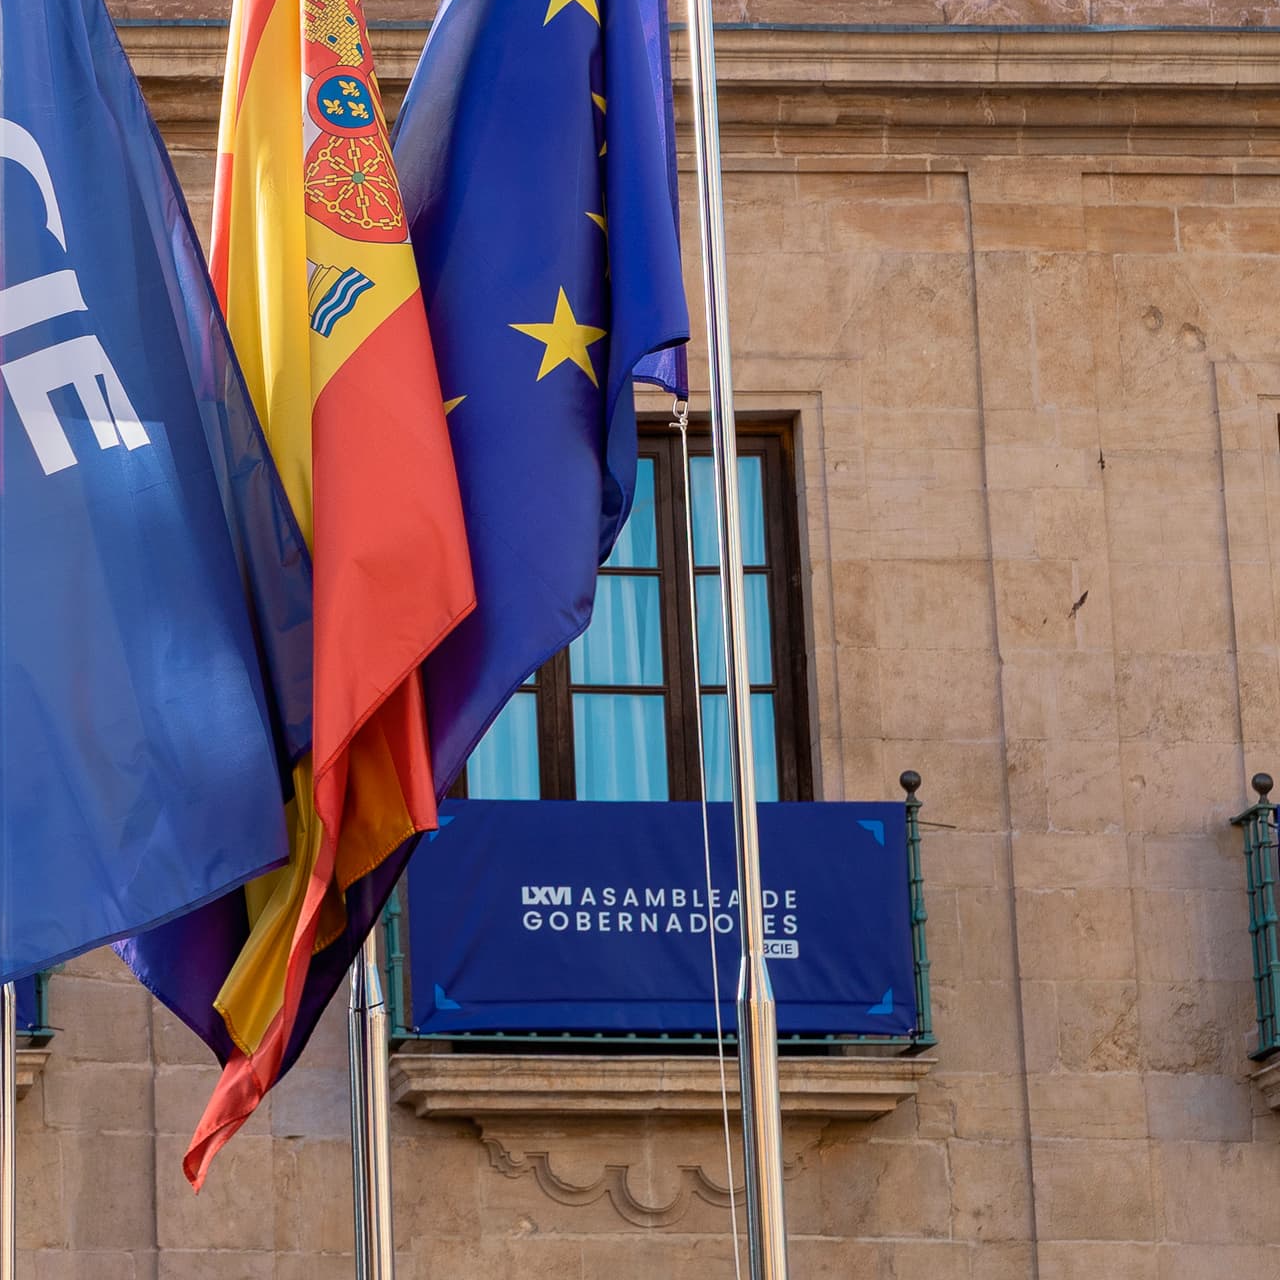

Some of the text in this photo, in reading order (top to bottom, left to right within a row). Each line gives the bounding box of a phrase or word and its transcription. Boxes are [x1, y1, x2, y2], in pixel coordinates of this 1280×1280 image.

[521, 886, 572, 906] LXVI
[762, 890, 798, 910] DE
[522, 910, 799, 934] GOBERNADOES
